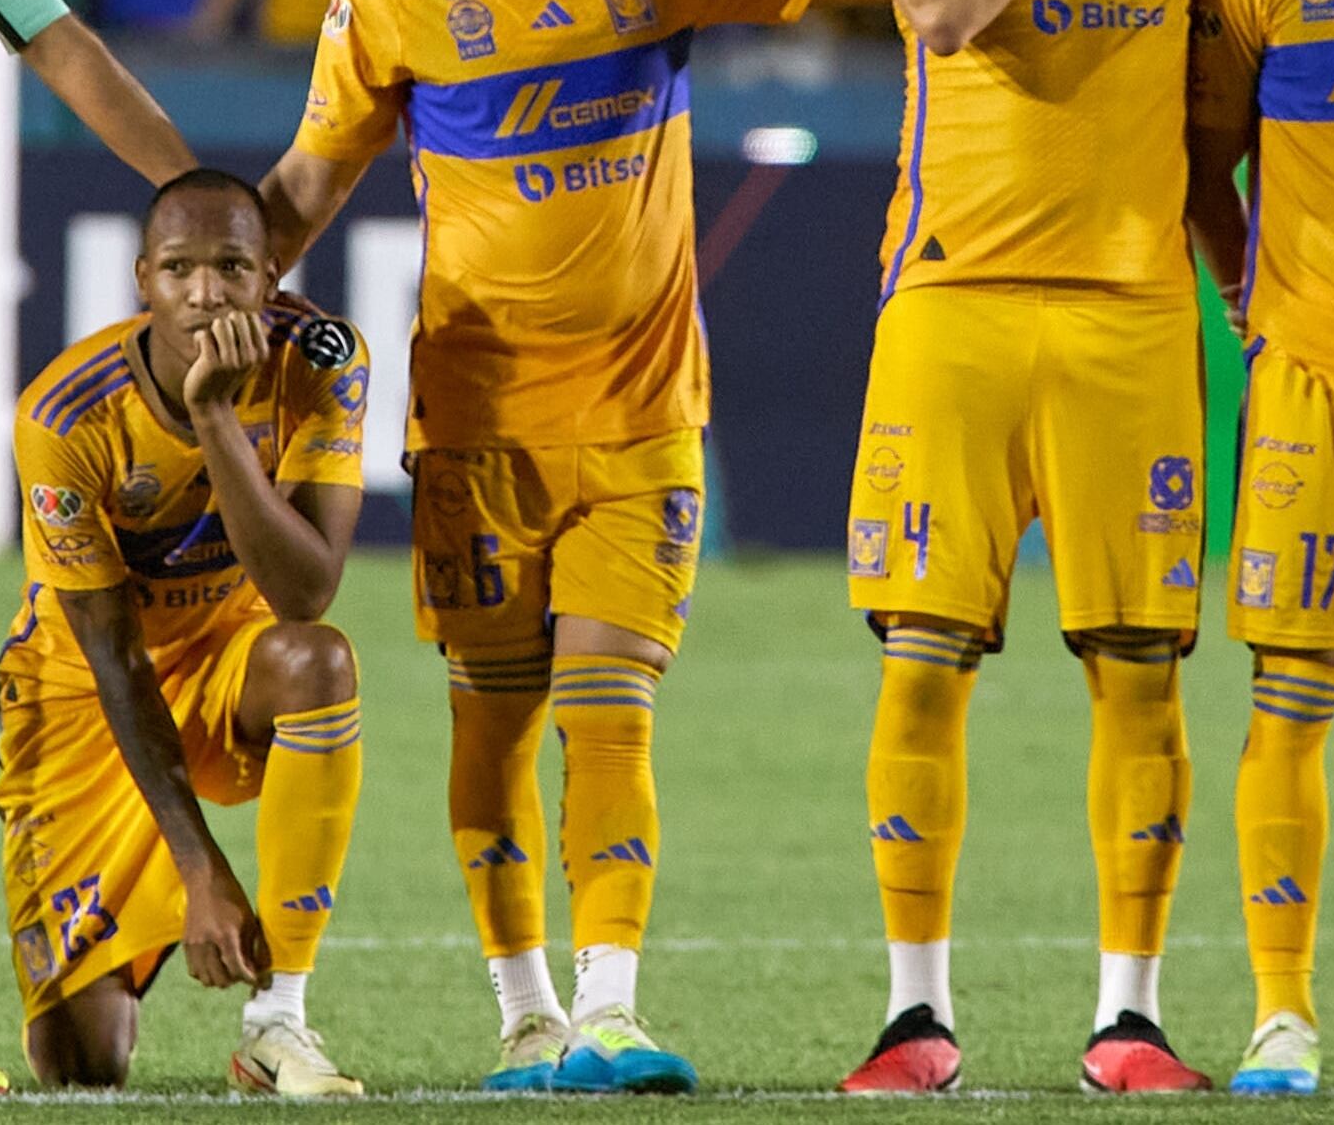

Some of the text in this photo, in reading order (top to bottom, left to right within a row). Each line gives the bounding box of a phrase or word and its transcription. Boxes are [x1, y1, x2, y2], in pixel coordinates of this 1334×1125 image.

[1082, 0, 1165, 29] Bitso
[548, 86, 656, 130] CEMEX
[562, 152, 645, 193] Bitso
[903, 500, 931, 580] 4
